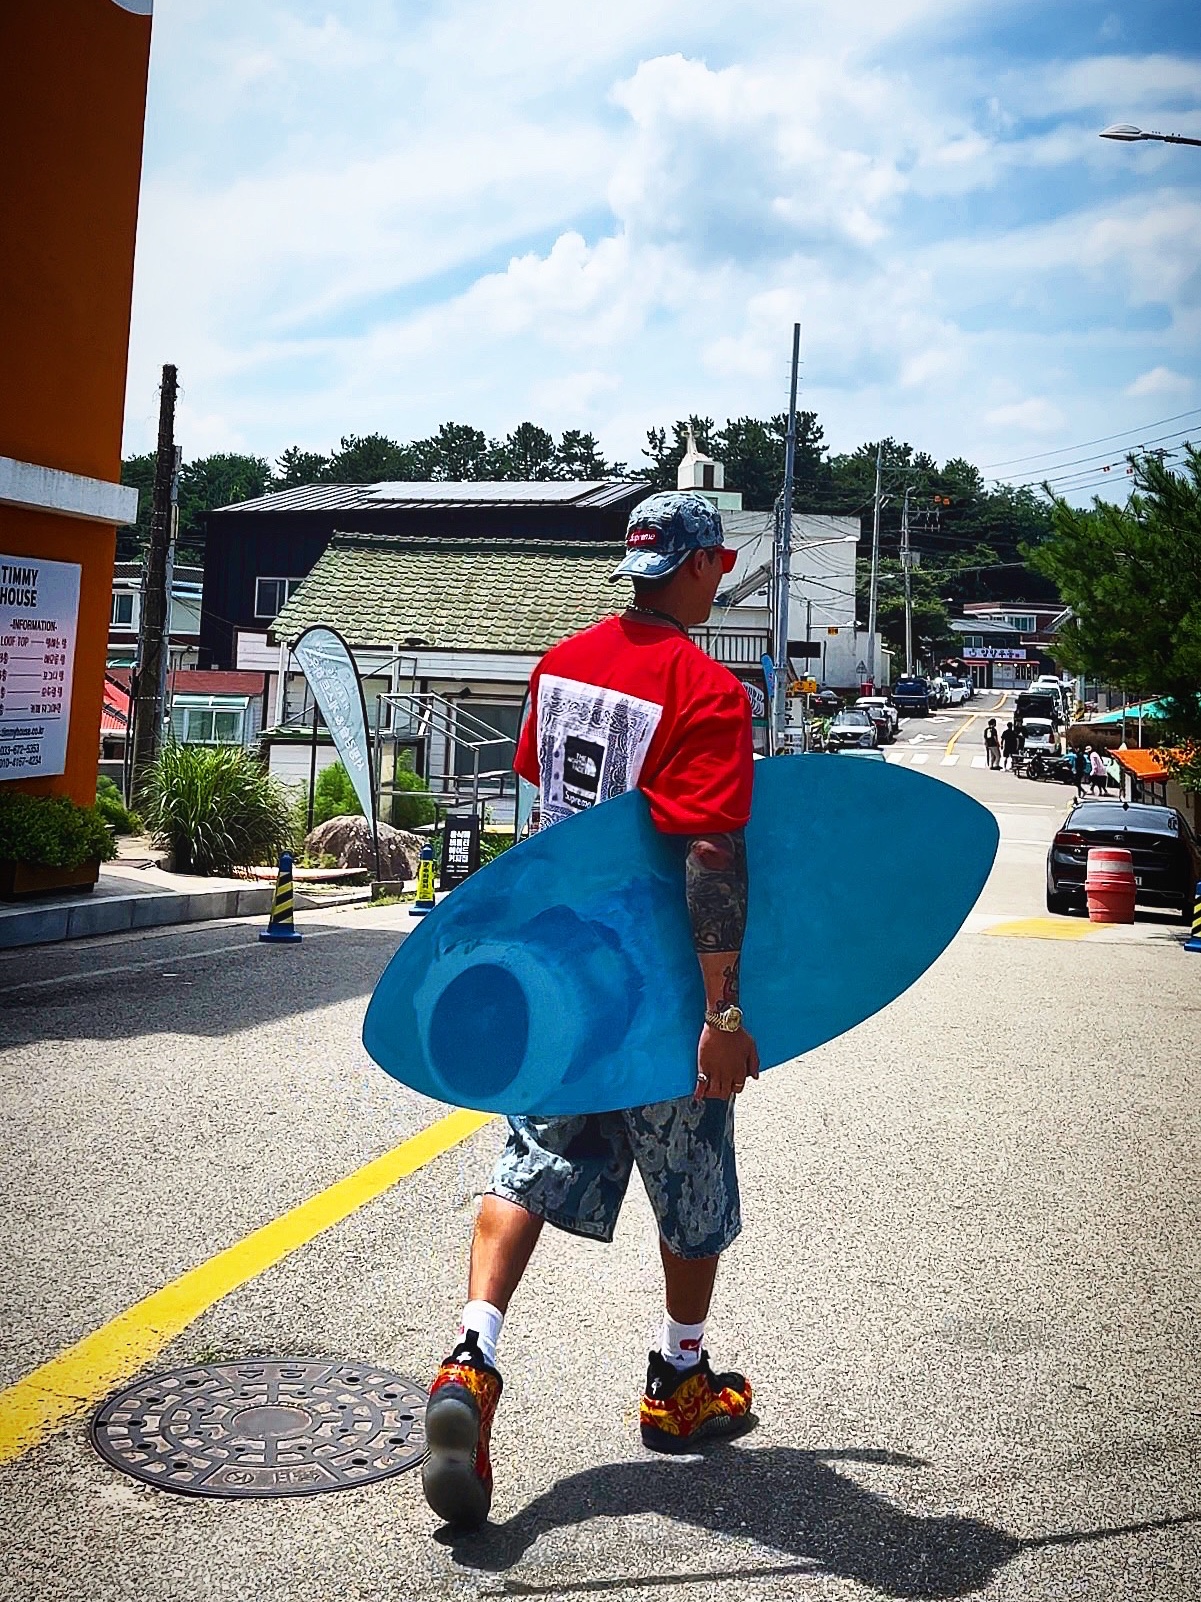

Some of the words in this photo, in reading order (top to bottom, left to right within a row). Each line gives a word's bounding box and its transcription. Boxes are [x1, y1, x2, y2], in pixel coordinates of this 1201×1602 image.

[1, 565, 39, 586] TIMMY
[0, 587, 38, 608] HOUSE
[18, 635, 30, 648] TOP
